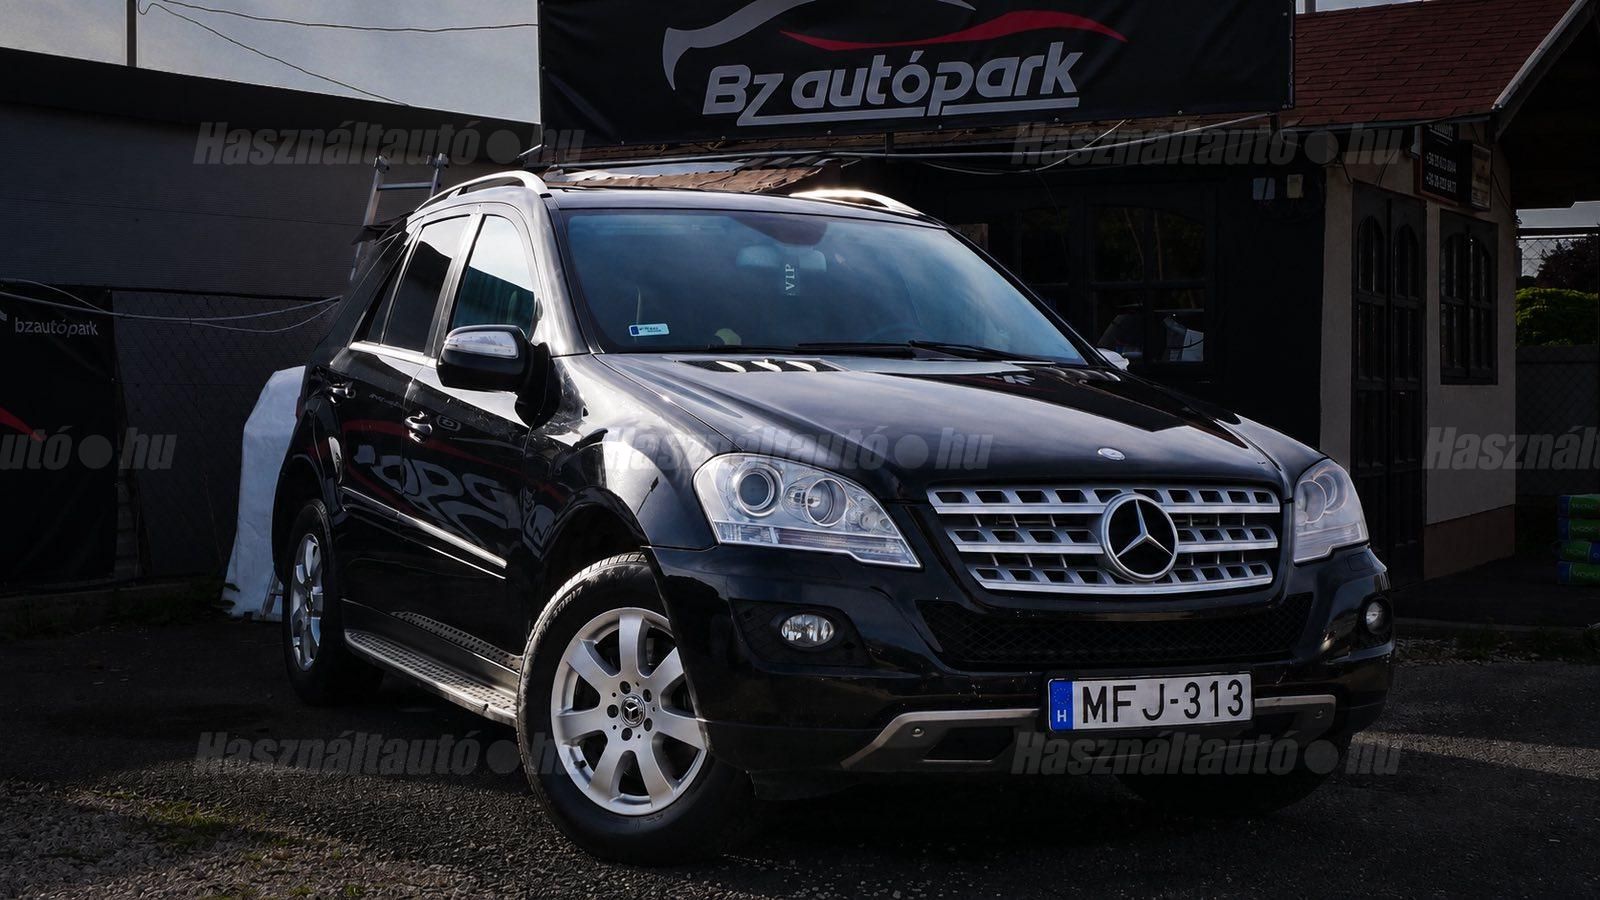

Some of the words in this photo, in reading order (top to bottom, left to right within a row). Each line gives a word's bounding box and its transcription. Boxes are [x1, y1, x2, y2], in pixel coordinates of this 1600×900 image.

[791, 42, 1083, 117] autópark
[785, 263, 796, 291] VIP
[14, 317, 99, 338] bzautópark
[1057, 710, 1067, 723] H
